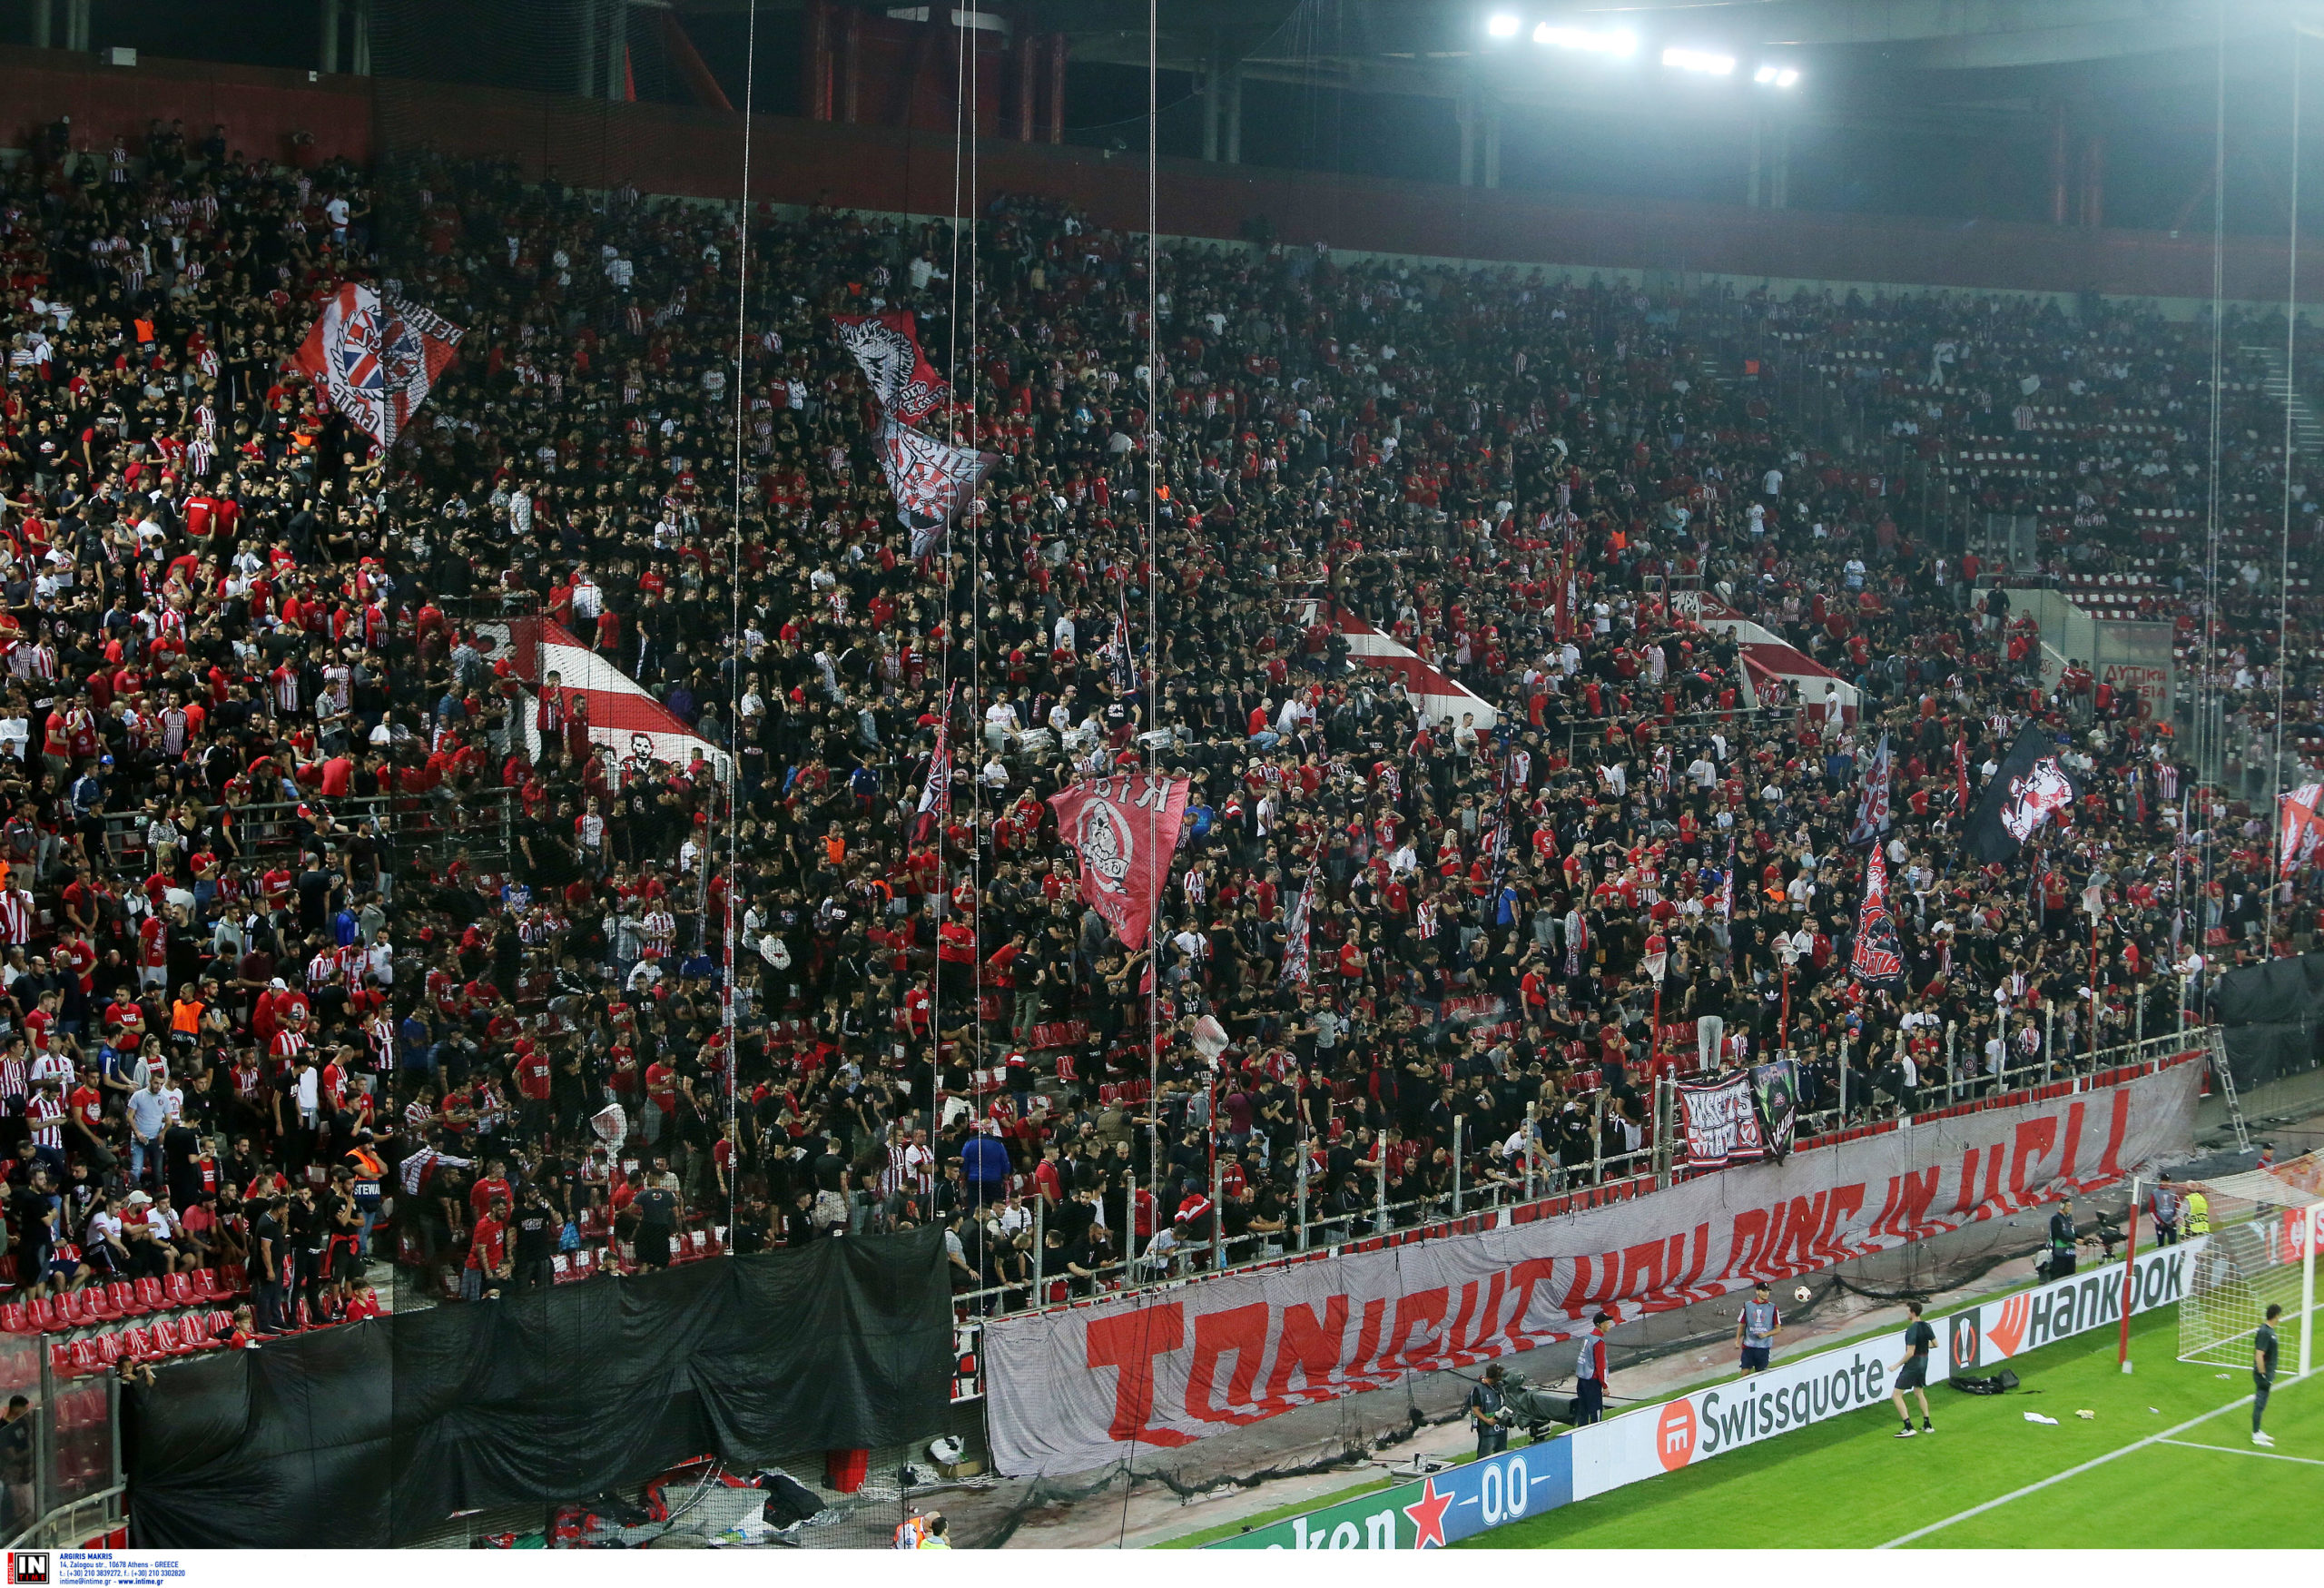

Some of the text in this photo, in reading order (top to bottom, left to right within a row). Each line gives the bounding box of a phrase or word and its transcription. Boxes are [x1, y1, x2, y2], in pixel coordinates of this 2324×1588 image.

[1702, 1353, 1884, 1453] Swissquote
[1266, 1455, 1528, 1549] ken 0.0
